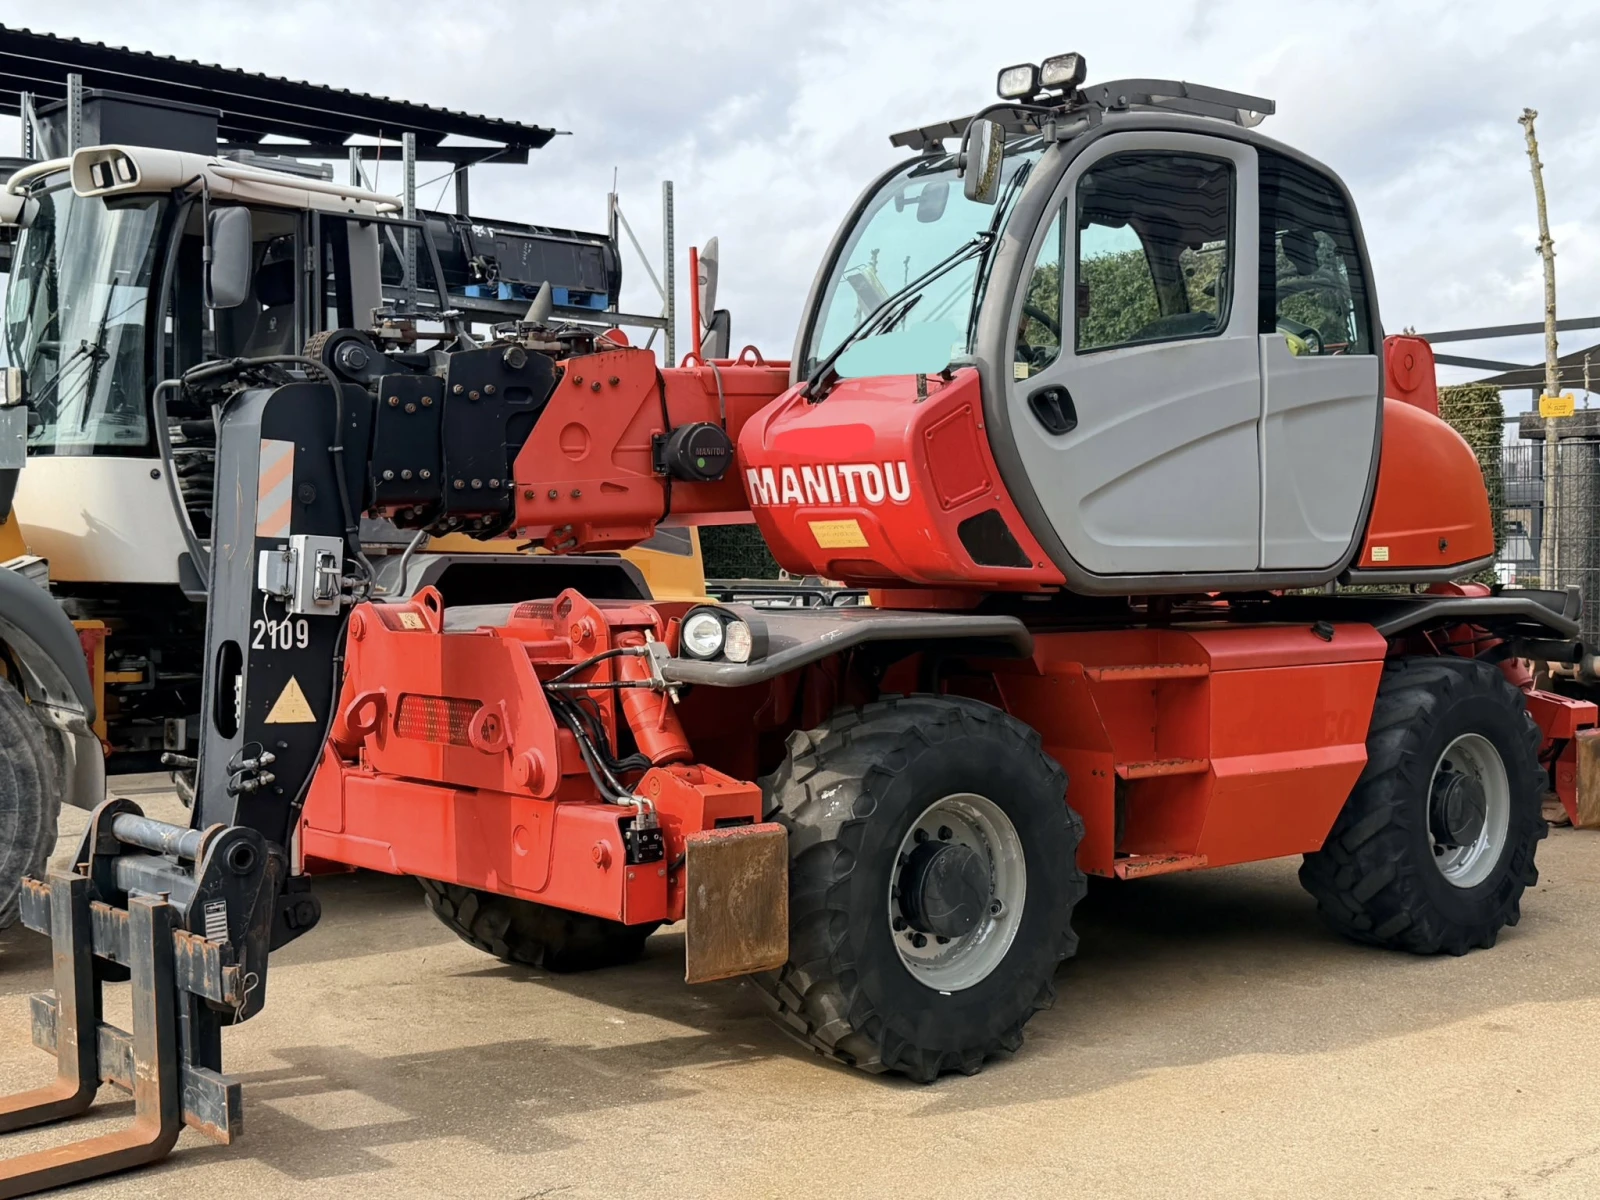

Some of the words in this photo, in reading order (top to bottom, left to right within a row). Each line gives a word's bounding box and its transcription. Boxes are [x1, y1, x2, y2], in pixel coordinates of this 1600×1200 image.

[695, 447, 725, 456] MANITOU
[746, 461, 911, 505] MANITOU
[251, 619, 309, 650] 2109
